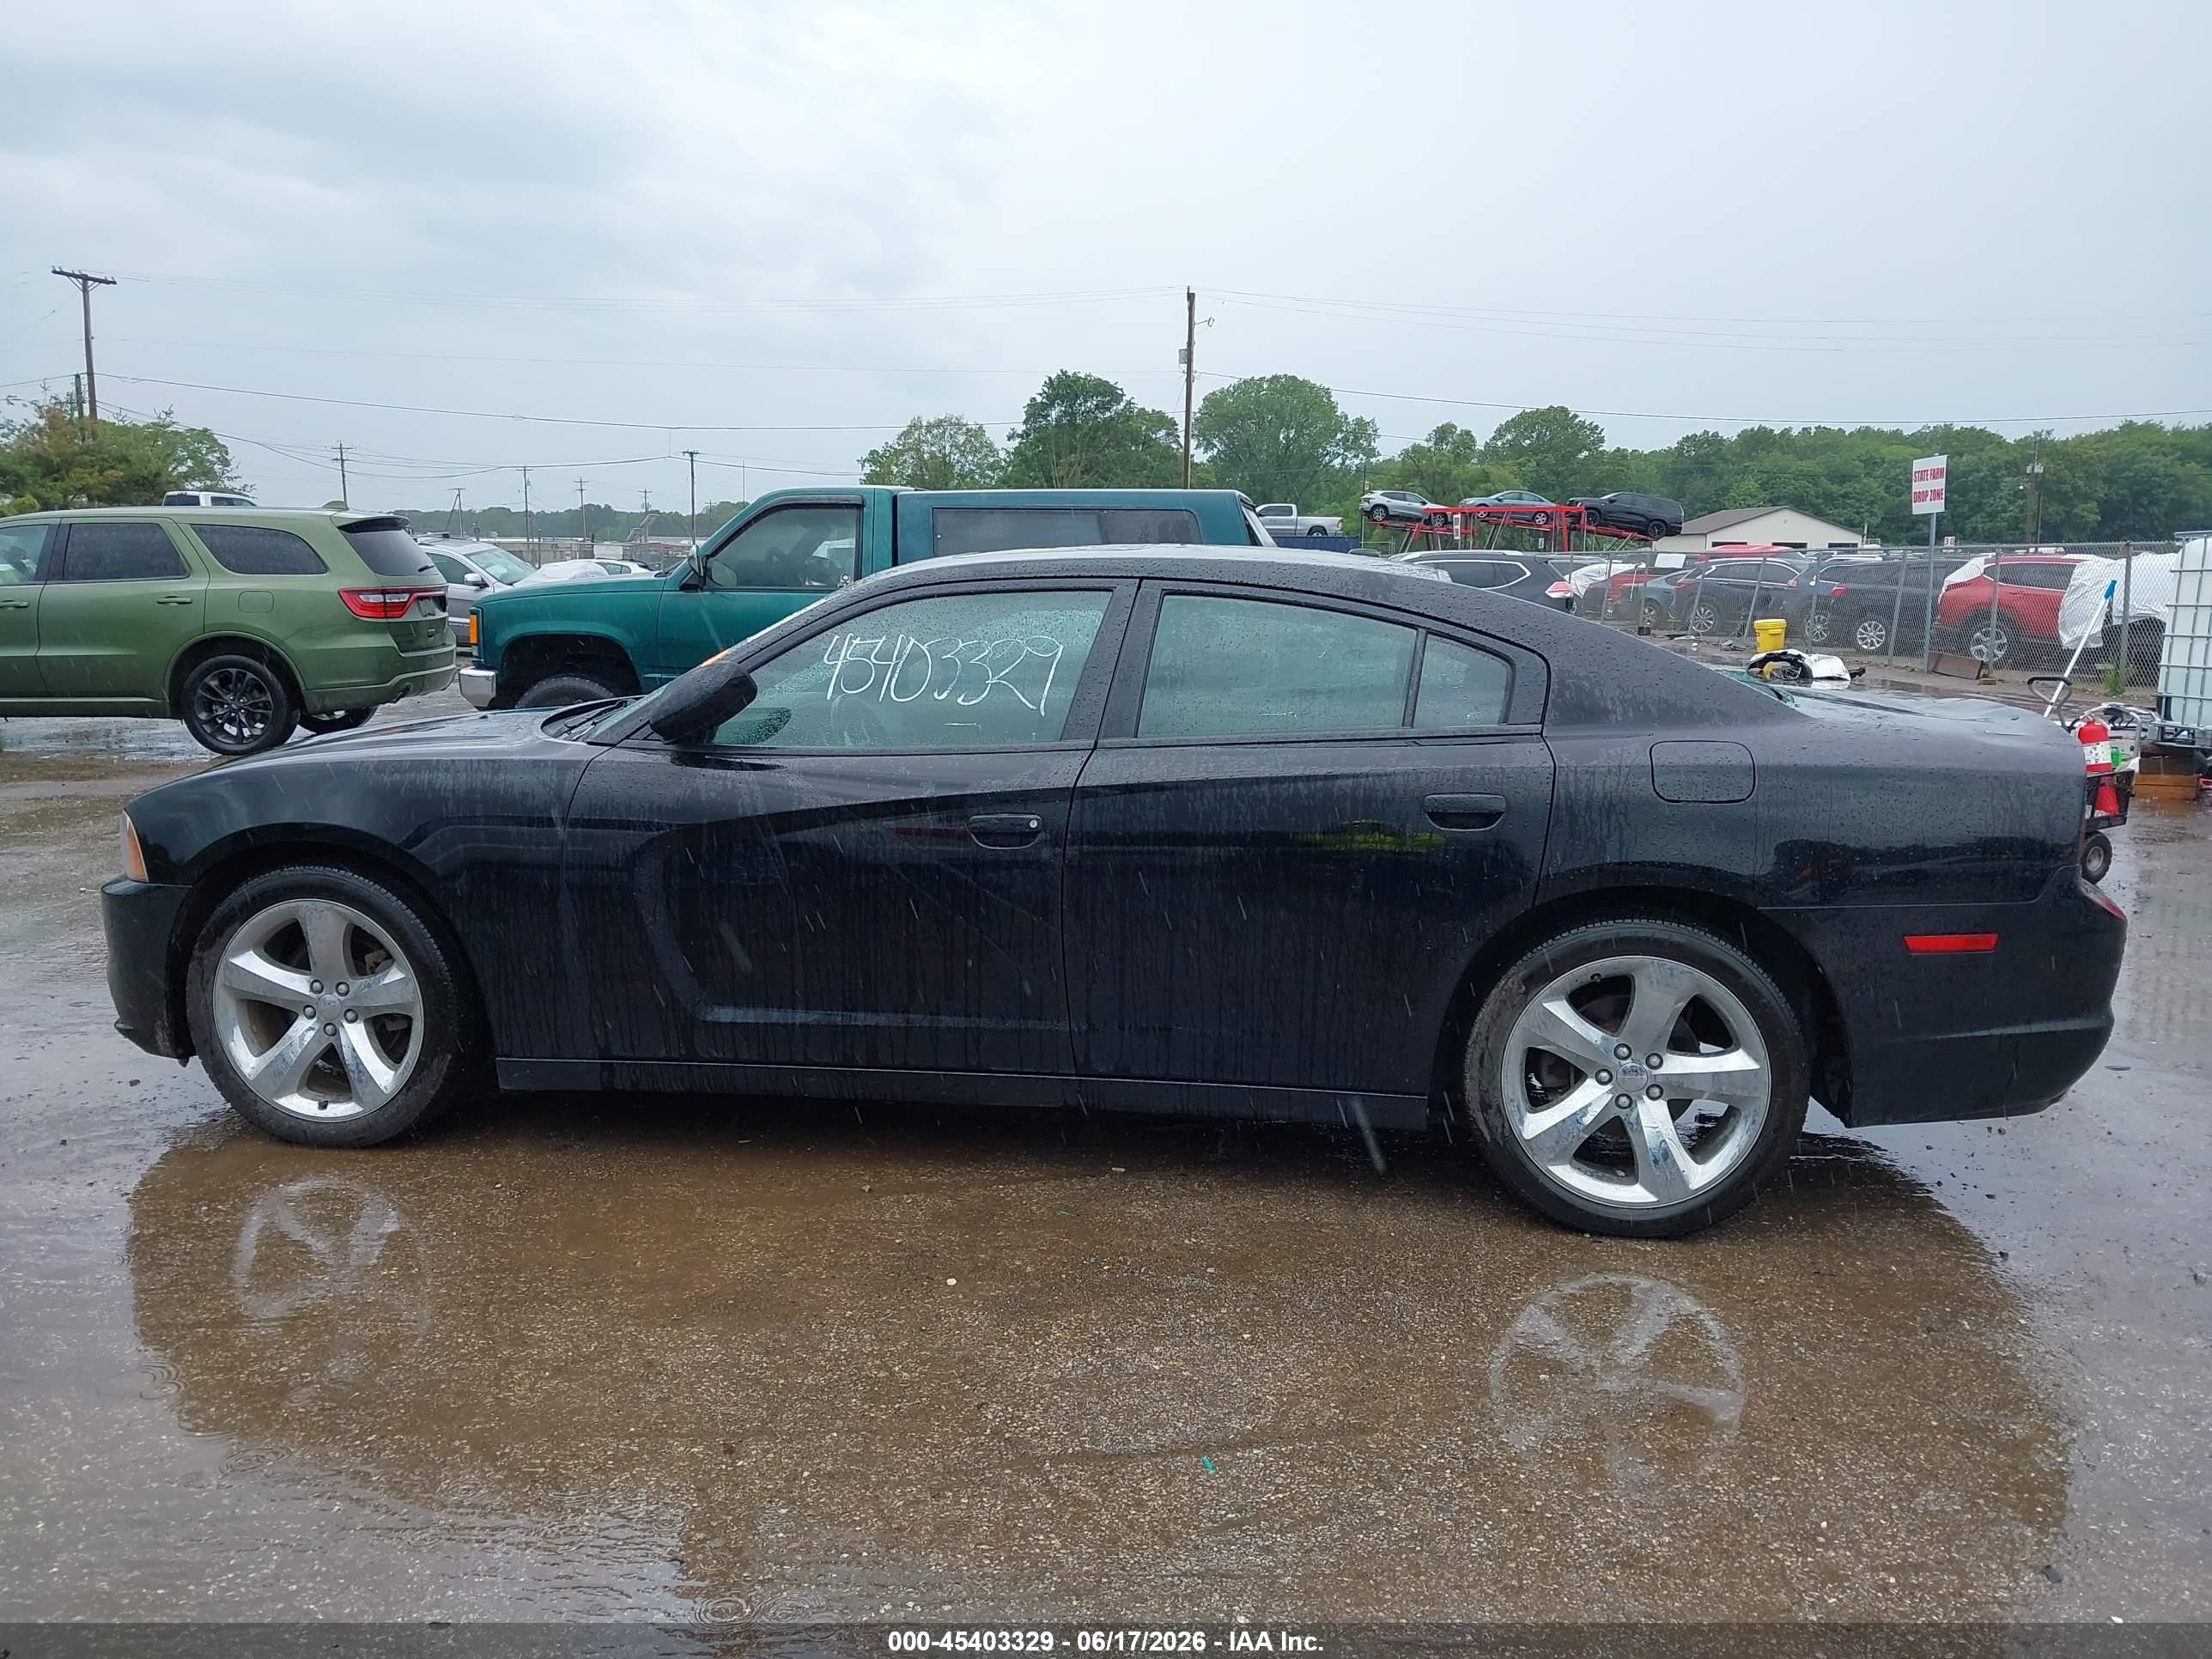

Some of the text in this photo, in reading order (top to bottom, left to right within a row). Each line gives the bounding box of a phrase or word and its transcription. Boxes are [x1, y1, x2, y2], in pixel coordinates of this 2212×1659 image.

[1914, 467, 1944, 482] STATE FARM
[1914, 489, 1943, 503] DROP ZONE
[823, 633, 1064, 717] 45403329
